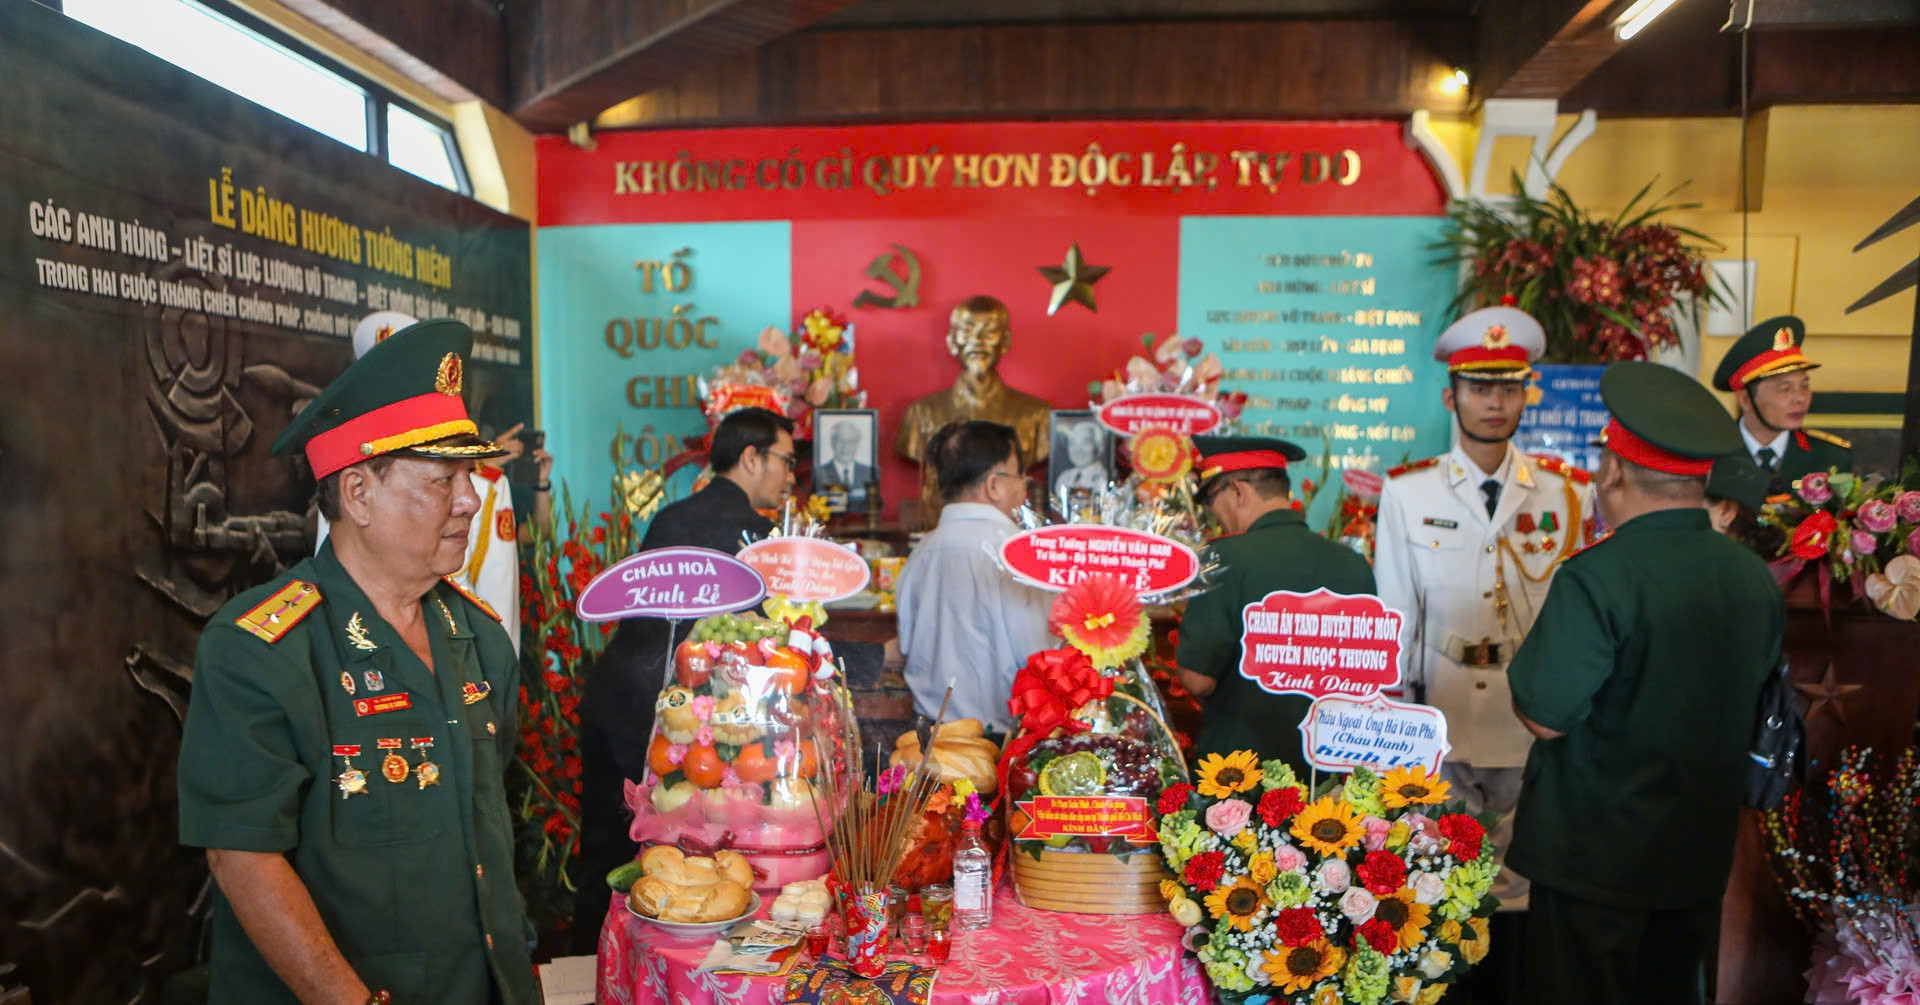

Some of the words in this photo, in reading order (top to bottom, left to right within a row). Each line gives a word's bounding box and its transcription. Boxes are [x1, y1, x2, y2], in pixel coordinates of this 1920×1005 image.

[615, 150, 746, 194] KHÔNG
[755, 148, 805, 190] CÓ
[862, 147, 943, 195] QUÝ
[952, 150, 1041, 188] HƠN
[1049, 142, 1132, 196] ĐỘC
[1230, 149, 1292, 195] TỰ
[1301, 148, 1362, 188] DO
[209, 166, 237, 230] LỄ
[240, 185, 297, 247] DÂNG
[301, 208, 362, 265] HƯƠNG
[364, 224, 414, 280] TƯỞNG
[29, 198, 73, 243] CÁC
[76, 211, 118, 253] ANH
[119, 218, 169, 263] HÙNG
[185, 234, 215, 279] LIỆT
[235, 250, 262, 288] LỰC
[264, 255, 304, 294] LƯỢNG
[36, 258, 89, 293] TRONG
[91, 268, 117, 297] HAI
[120, 272, 157, 306] CUỘC
[159, 280, 201, 309] KHÁNG
[203, 287, 237, 317] CHIẾN
[604, 302, 720, 360] QUỐC
[1030, 534, 1057, 550] Trung
[1088, 536, 1128, 554] NGUYỄN
[1128, 540, 1149, 555] VĂN
[1149, 543, 1172, 557] NAM
[622, 560, 673, 583] CHÁU
[678, 557, 718, 576] HOÀ
[692, 584, 721, 605] Lễ
[1248, 606, 1279, 634] CHÁNH
[1279, 607, 1293, 634] ÁN
[1295, 613, 1319, 636] TAND
[1320, 610, 1351, 643] HUYỆN
[1352, 611, 1375, 640] HÓC
[1374, 612, 1398, 641] MÔN
[1254, 637, 1302, 666] NGUYỄN
[1303, 645, 1337, 671] NGỌC
[1062, 823, 1084, 833] KÍNH
